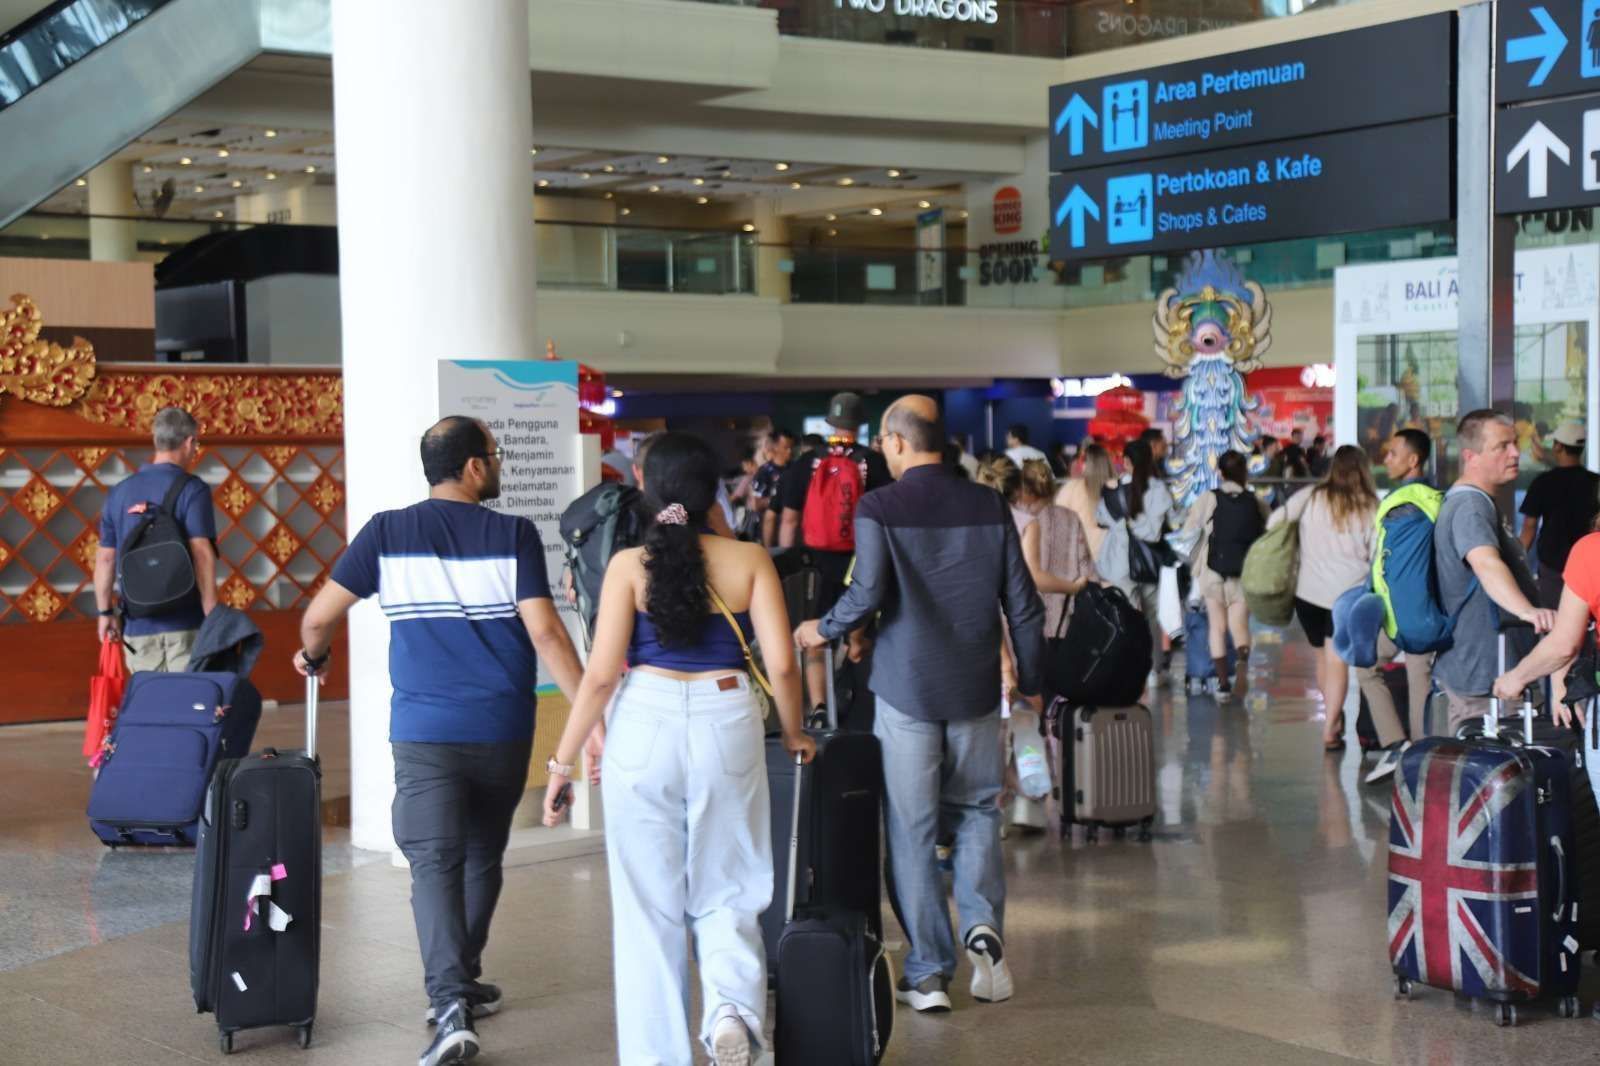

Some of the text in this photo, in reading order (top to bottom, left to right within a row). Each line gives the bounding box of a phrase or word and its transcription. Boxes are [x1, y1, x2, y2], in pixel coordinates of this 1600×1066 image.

[893, 0, 998, 24] DRAGONS
[1154, 61, 1305, 104] Area Pertemuan
[1153, 109, 1253, 141] Meeting Point
[1156, 153, 1322, 196] Pertokoan & Kafe
[1158, 202, 1267, 232] Shops & Cafes
[980, 240, 1038, 258] OPENING
[1405, 280, 1441, 300] BALI
[508, 418, 559, 432] Pengguna
[506, 450, 554, 463] Menjamin
[511, 465, 575, 478] Kenyamanan
[501, 481, 558, 493] eselamatan
[507, 496, 555, 508] Dihimbau
